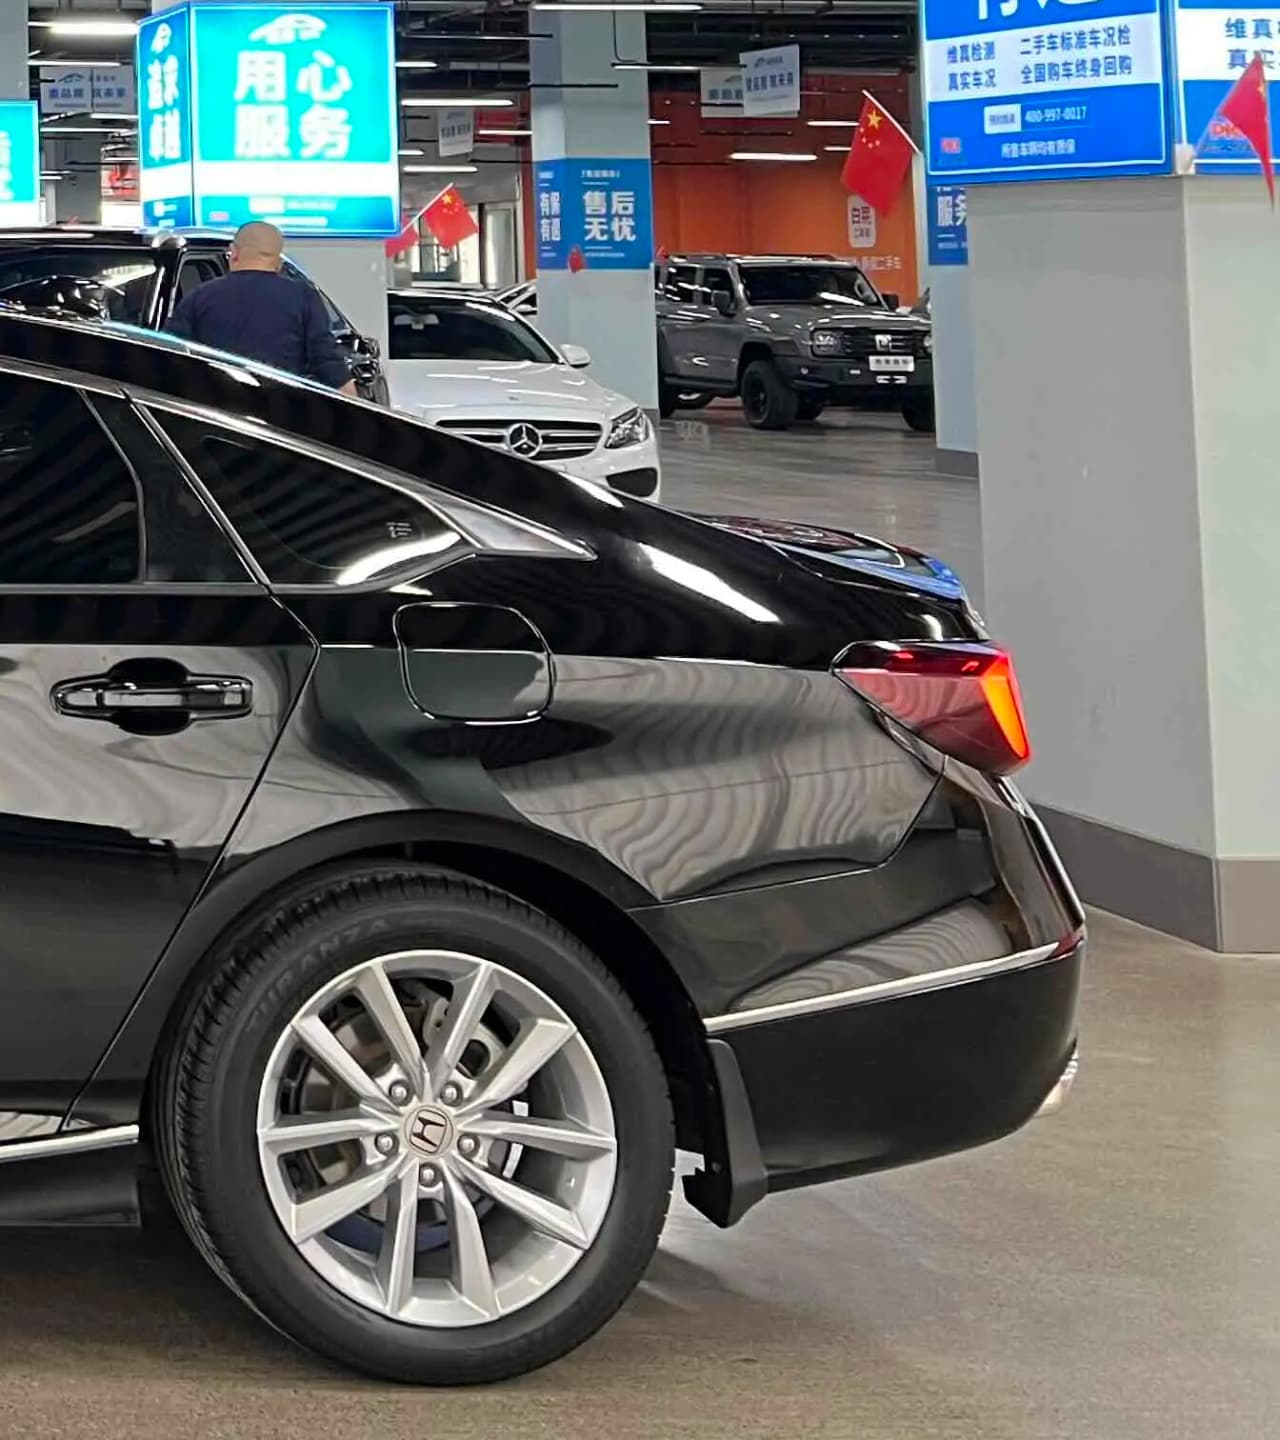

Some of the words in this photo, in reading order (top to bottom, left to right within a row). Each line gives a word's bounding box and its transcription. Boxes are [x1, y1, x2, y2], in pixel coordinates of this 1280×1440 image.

[235, 48, 352, 103] 用心
[236, 103, 352, 160] 服务
[582, 190, 635, 216] 售后
[583, 216, 636, 242] 无忧
